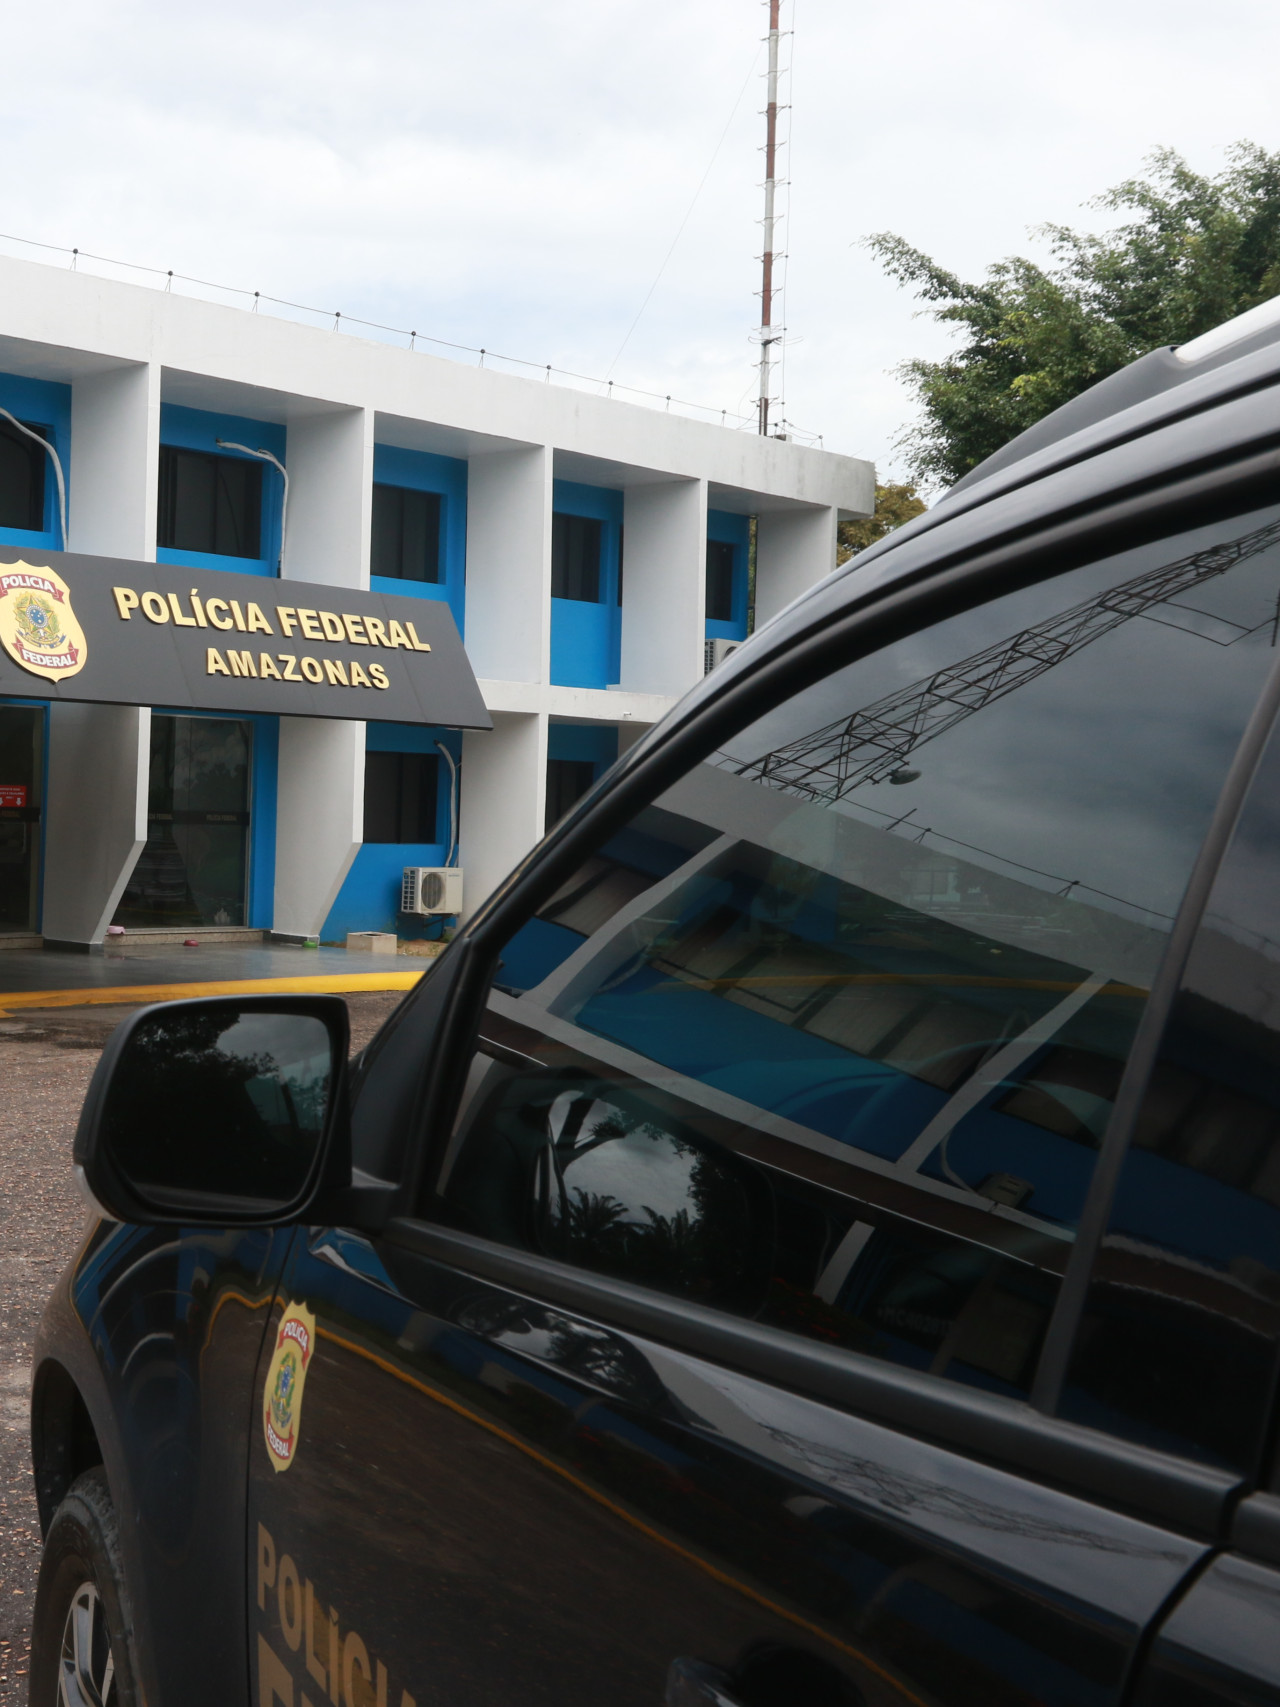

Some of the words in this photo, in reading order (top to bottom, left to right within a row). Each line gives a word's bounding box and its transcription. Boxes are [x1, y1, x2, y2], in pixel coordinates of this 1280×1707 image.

[112, 586, 275, 635] POLÍCIA
[275, 606, 432, 652] FEDERAL
[21, 648, 76, 667] FEDERAL
[205, 647, 390, 691] AMAZONAS
[266, 1422, 290, 1458] FEDERAL
[257, 1520, 418, 1707] POLÍCI
